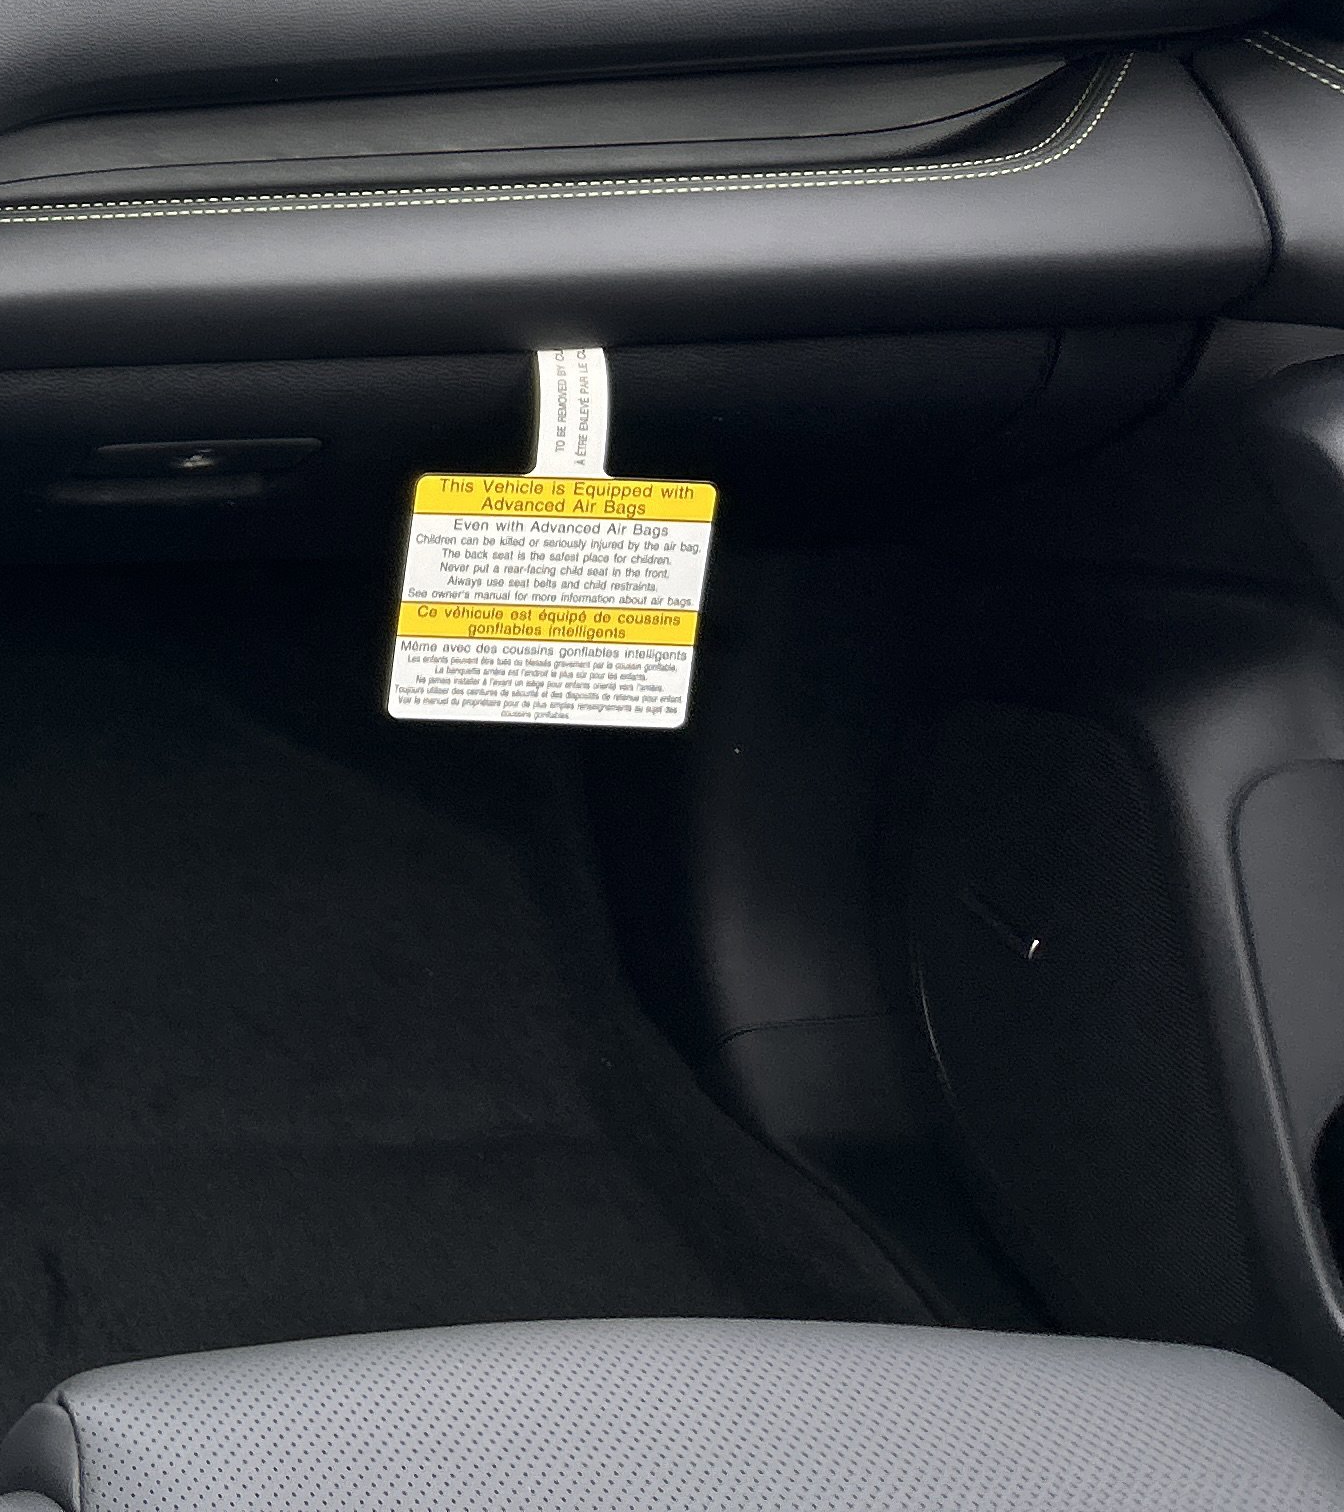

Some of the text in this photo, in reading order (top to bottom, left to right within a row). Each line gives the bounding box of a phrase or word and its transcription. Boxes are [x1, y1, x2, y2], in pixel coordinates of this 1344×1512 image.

[440, 478, 694, 500] This Vehicle is Equipped with
[481, 496, 646, 518] Advanced Air Bags
[453, 518, 669, 539] Even with Advanced Air Bags
[416, 533, 457, 545] Children
[461, 536, 479, 546] can
[483, 536, 496, 546] be
[529, 539, 540, 547] or
[543, 538, 587, 551] seriously
[591, 539, 624, 552] injured
[628, 540, 641, 553] by
[644, 541, 660, 551] the
[664, 542, 677, 551] air
[680, 541, 701, 555] bag.
[442, 548, 461, 559] The
[464, 549, 488, 560] back
[492, 550, 513, 560] seat
[517, 550, 526, 560] is
[530, 550, 546, 561] the
[583, 553, 610, 564] place
[614, 553, 627, 563] for
[631, 554, 672, 566] children.
[440, 561, 470, 573] Never
[473, 563, 490, 575] put
[560, 565, 584, 576] child
[587, 567, 609, 577] seat
[612, 567, 621, 577] in
[625, 567, 641, 578] the
[447, 575, 482, 589] Always
[486, 578, 505, 587] use
[508, 578, 530, 588] seat
[533, 578, 557, 589] belts
[561, 579, 580, 590] and
[583, 579, 607, 590] child
[407, 587, 428, 599] See
[431, 589, 470, 599] owner's
[474, 590, 511, 601] manual
[514, 590, 528, 601] for
[532, 593, 557, 602] more
[560, 592, 615, 604] information
[618, 594, 648, 605] about
[650, 596, 664, 605] air
[417, 605, 438, 618] Ce
[510, 609, 532, 621] est
[593, 611, 611, 623] de
[617, 613, 681, 626] coussins
[468, 622, 626, 640] gonflables intelligents
[442, 643, 471, 653] avec
[476, 643, 497, 654] des
[502, 644, 554, 656] coussins
[559, 646, 619, 659] gonflables
[624, 648, 687, 662] intelligents
